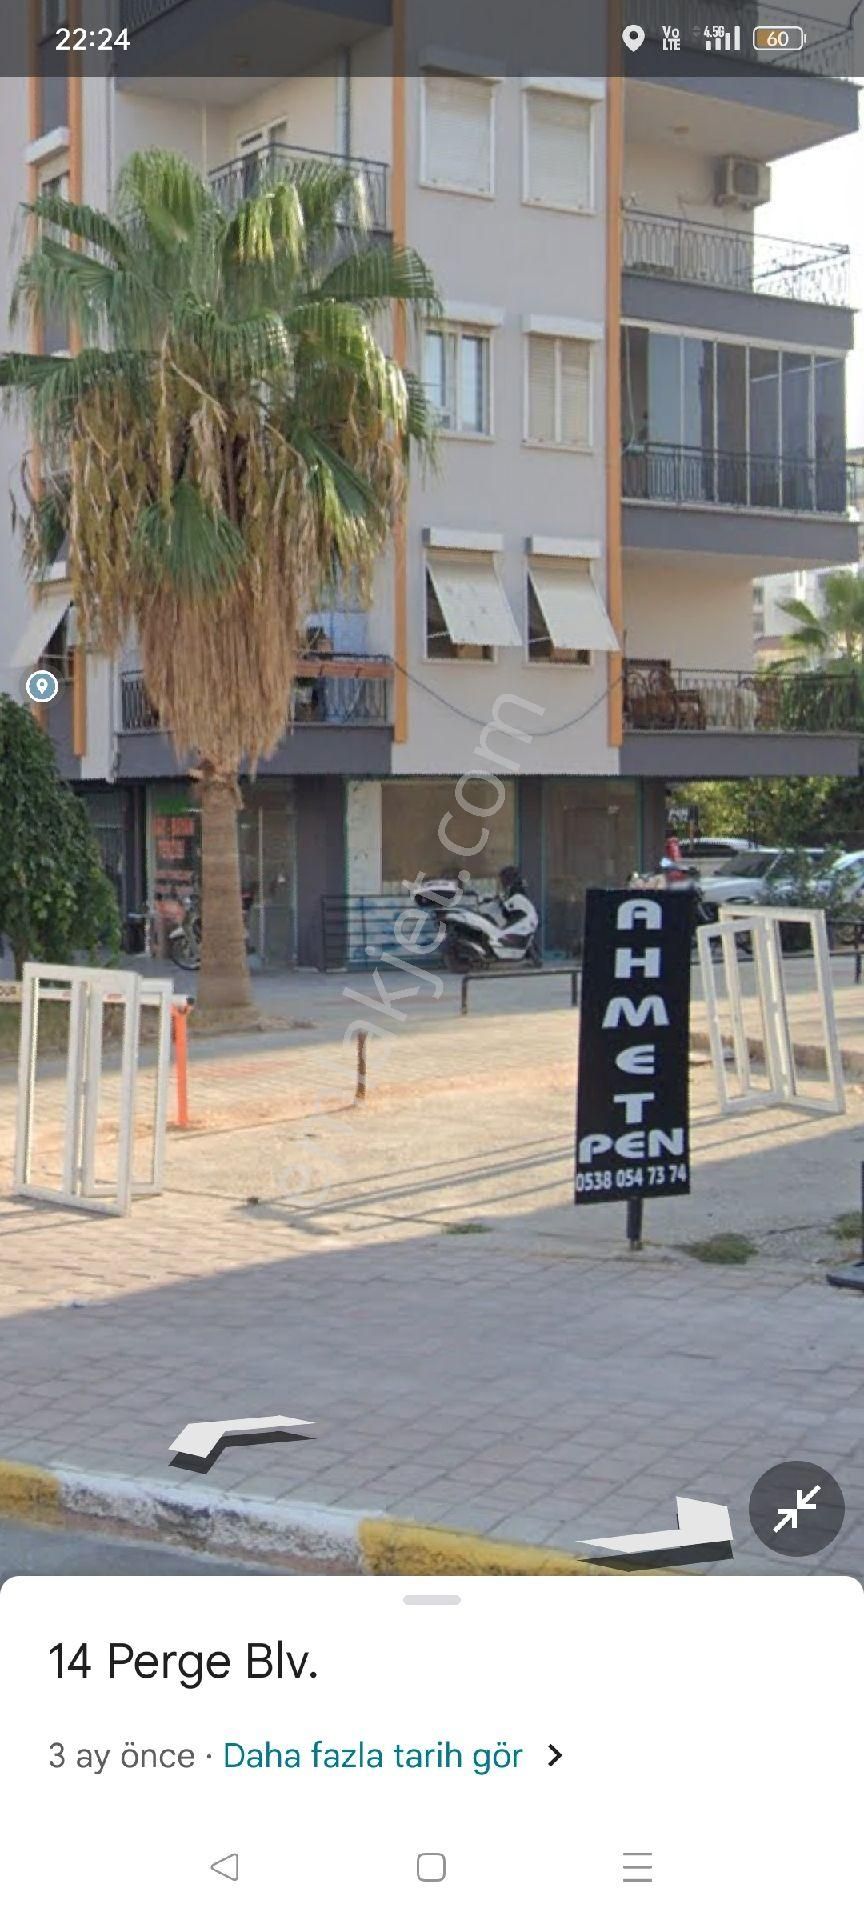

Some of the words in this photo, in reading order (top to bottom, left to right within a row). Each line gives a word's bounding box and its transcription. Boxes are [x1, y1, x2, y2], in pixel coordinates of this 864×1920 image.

[602, 898, 669, 1124] AHMET
[579, 1127, 684, 1163] PEN
[576, 1170, 612, 1192] 0538
[616, 1168, 643, 1188] 054
[648, 1165, 665, 1185] 73
[669, 1163, 687, 1183] 74
